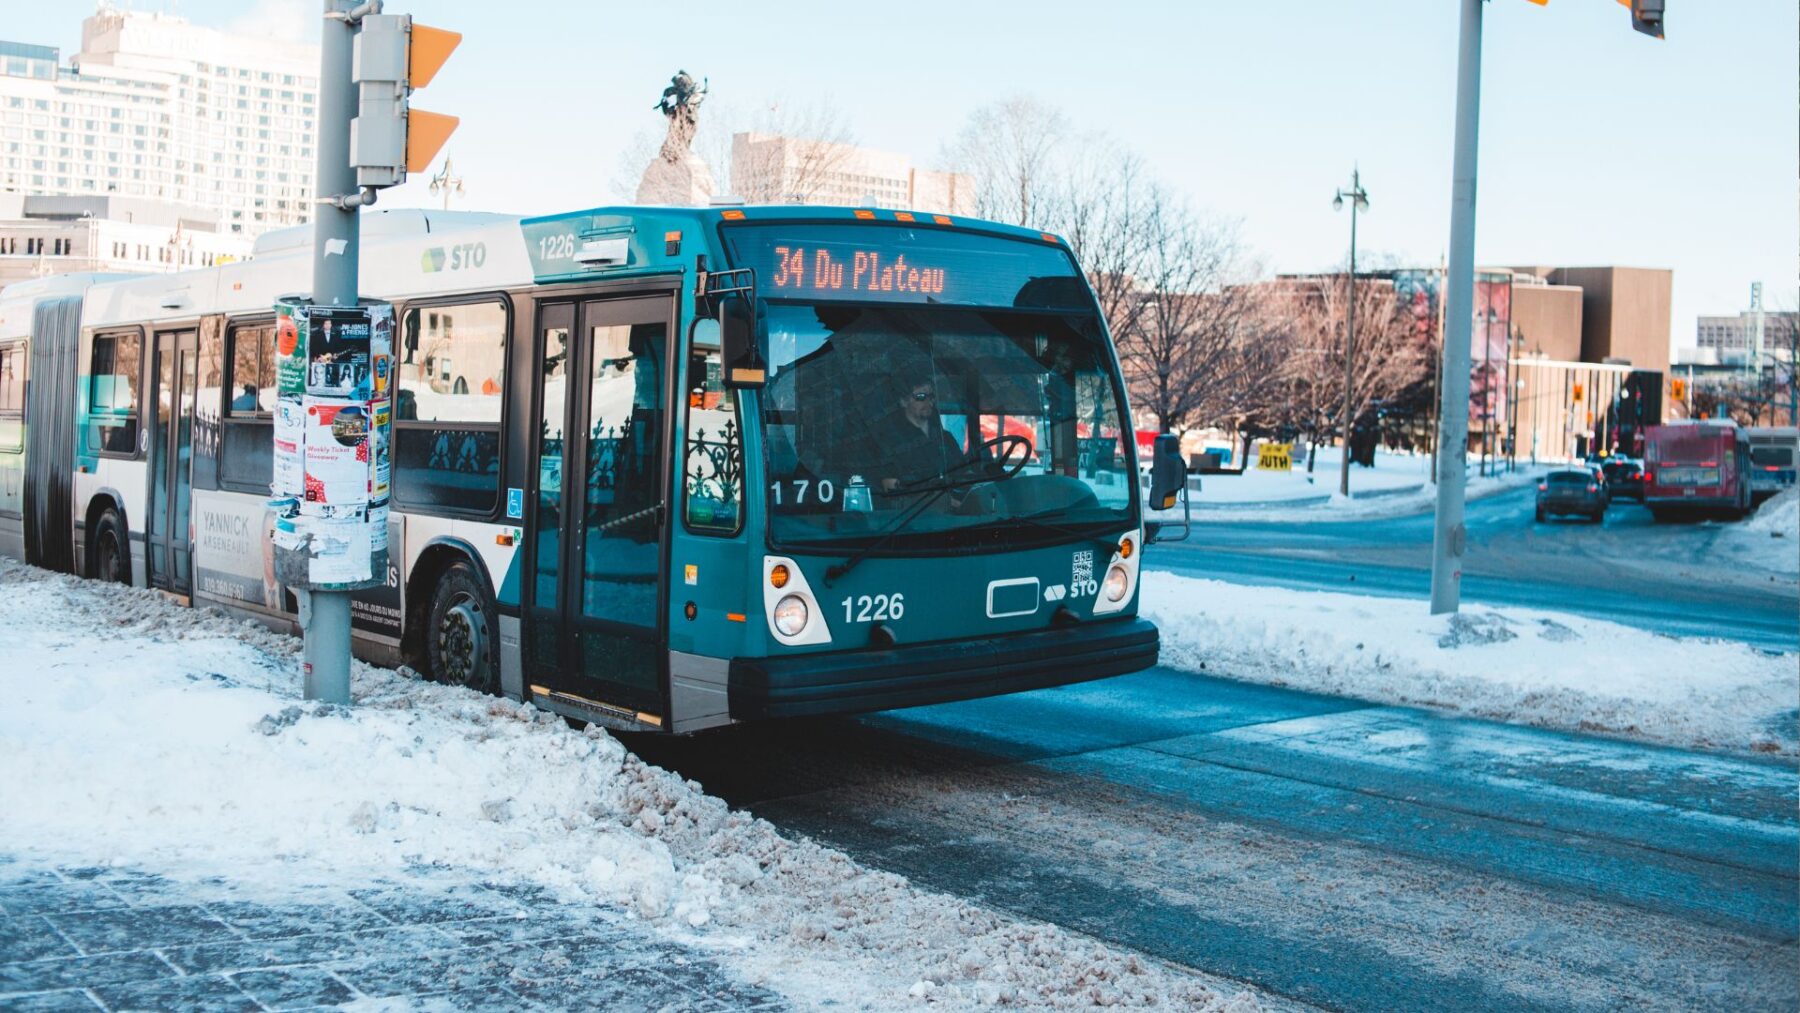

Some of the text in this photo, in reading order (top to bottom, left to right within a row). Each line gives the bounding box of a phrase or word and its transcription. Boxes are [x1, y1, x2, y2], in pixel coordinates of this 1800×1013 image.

[451, 241, 487, 270] STO
[540, 233, 574, 260] 1226
[774, 247, 945, 293] 34 Du Plateau
[307, 446, 330, 454] Weekly
[203, 511, 250, 537] YANNICK
[1070, 580, 1098, 598] STO
[841, 592, 905, 623] 1226
